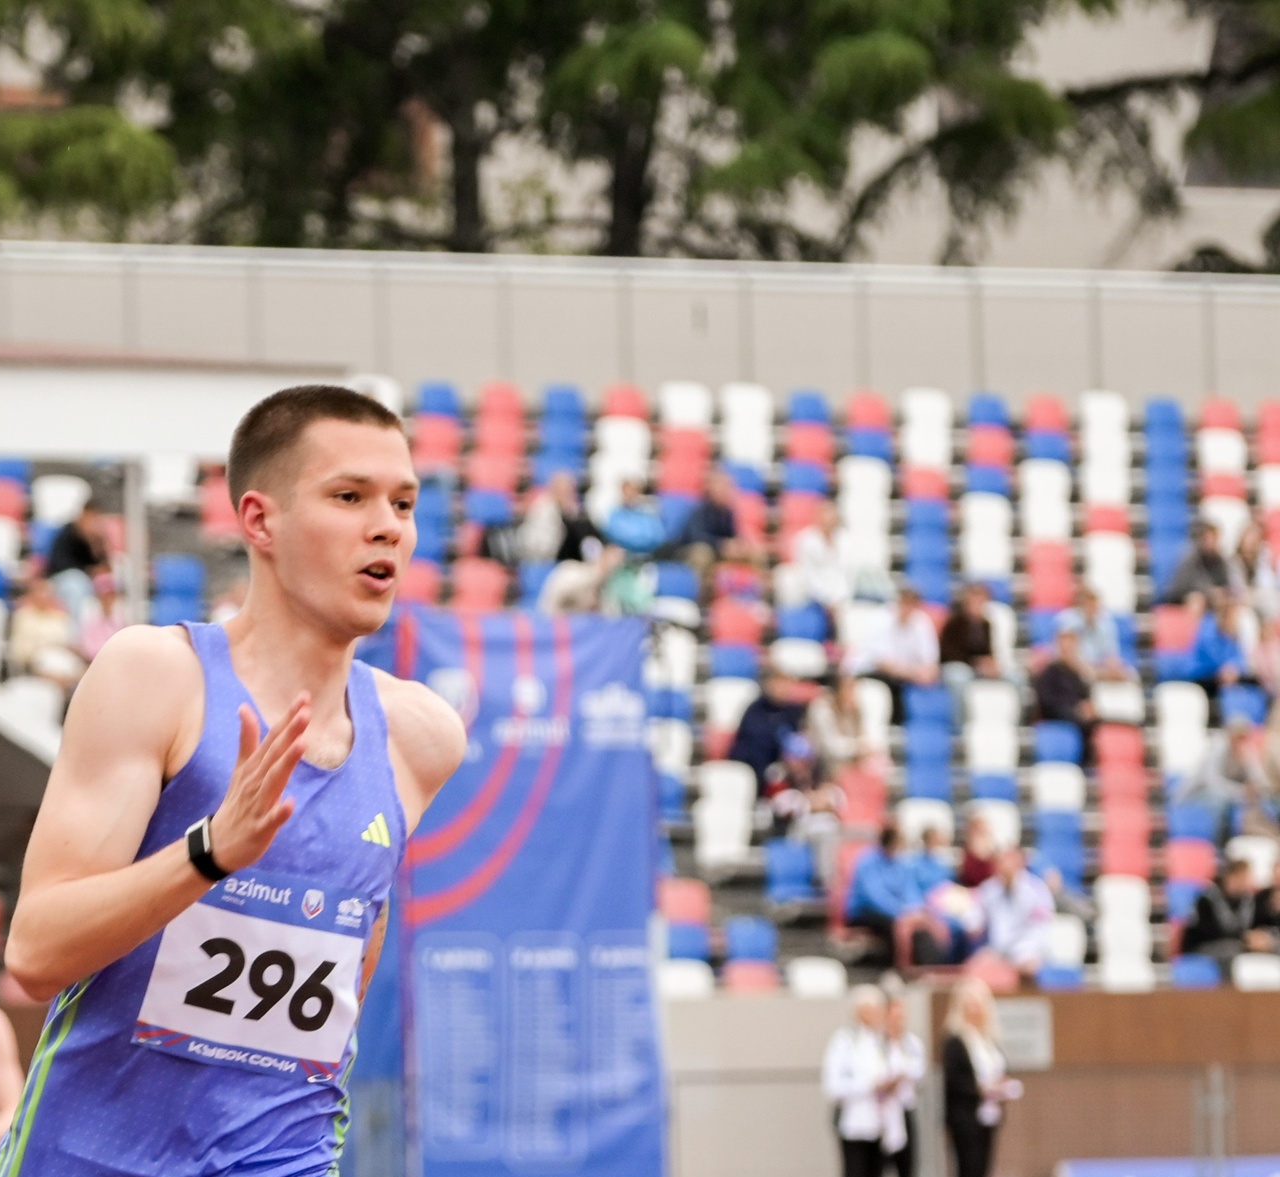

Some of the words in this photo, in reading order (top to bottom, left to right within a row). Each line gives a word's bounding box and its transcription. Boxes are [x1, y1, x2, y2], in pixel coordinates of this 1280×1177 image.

[224, 877, 293, 906] azimut
[183, 937, 339, 1032] 296
[248, 1053, 298, 1073] СОЧИ
